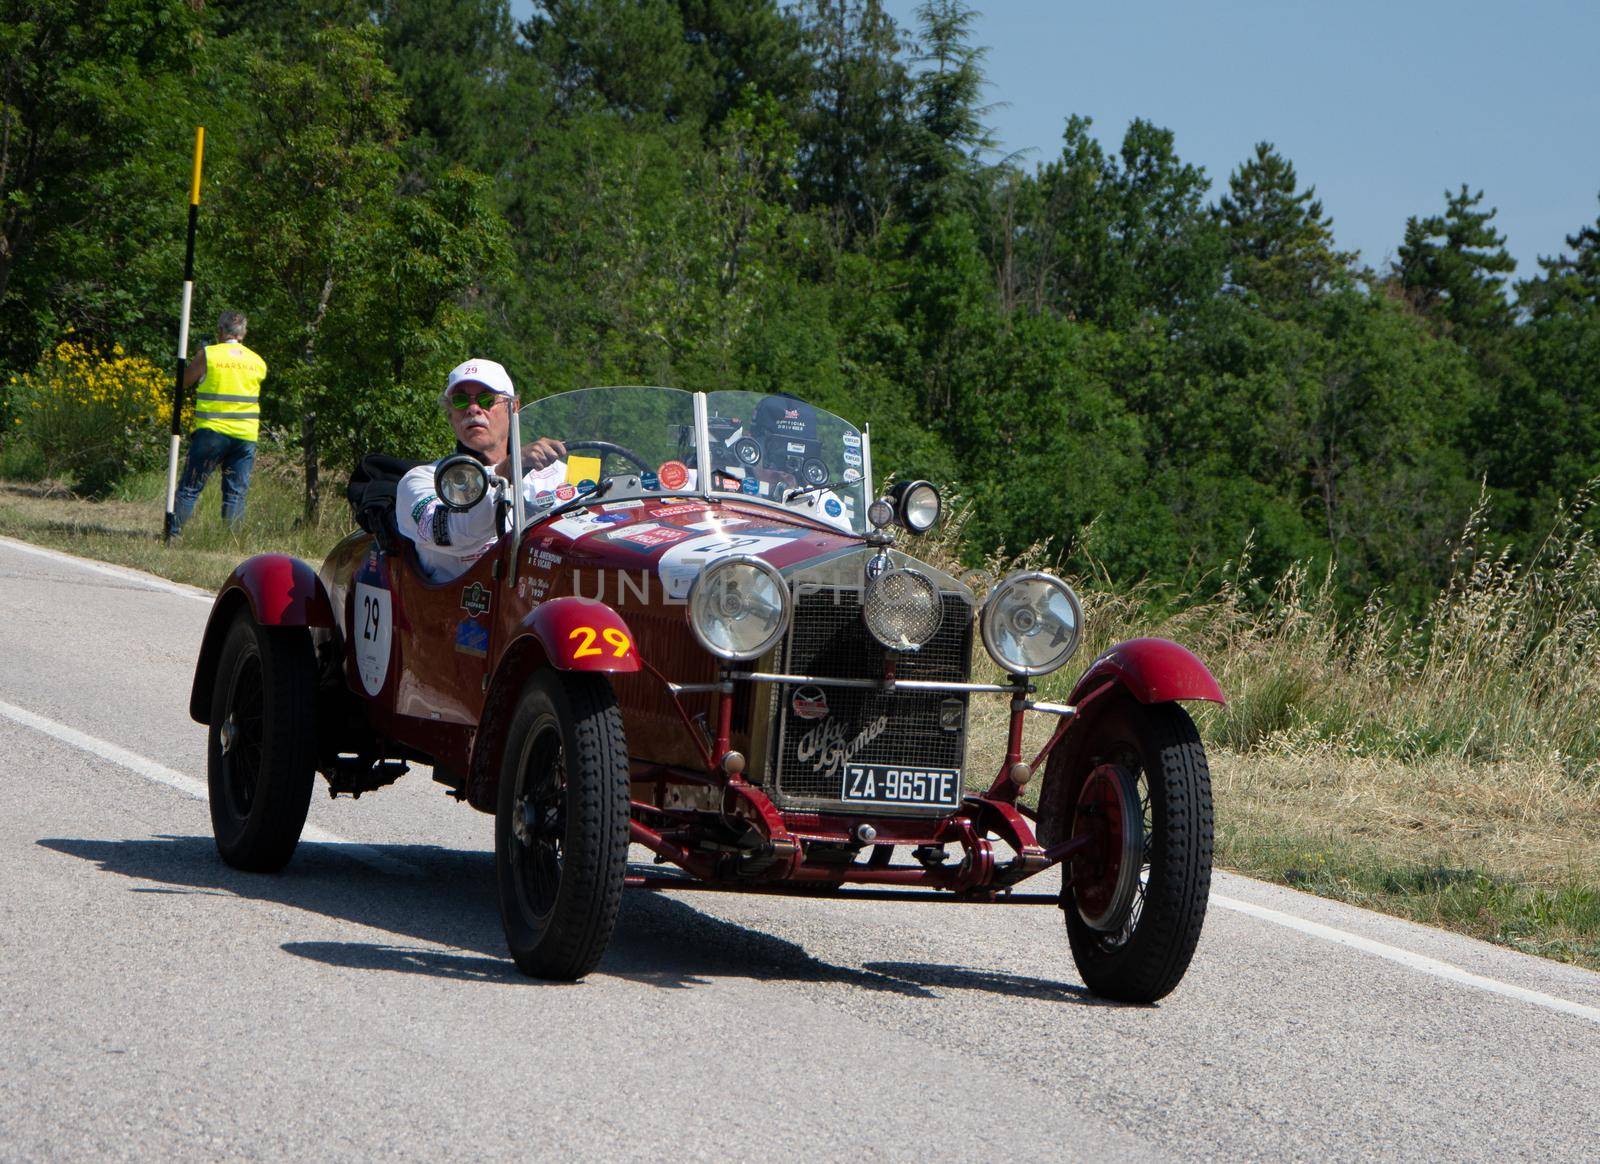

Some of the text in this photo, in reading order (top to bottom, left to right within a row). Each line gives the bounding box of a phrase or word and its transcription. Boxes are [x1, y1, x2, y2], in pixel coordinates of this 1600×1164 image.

[464, 366, 478, 375] 29
[363, 595, 380, 642] 29
[568, 627, 631, 660] 29
[849, 767, 954, 802] ZA-965TE
